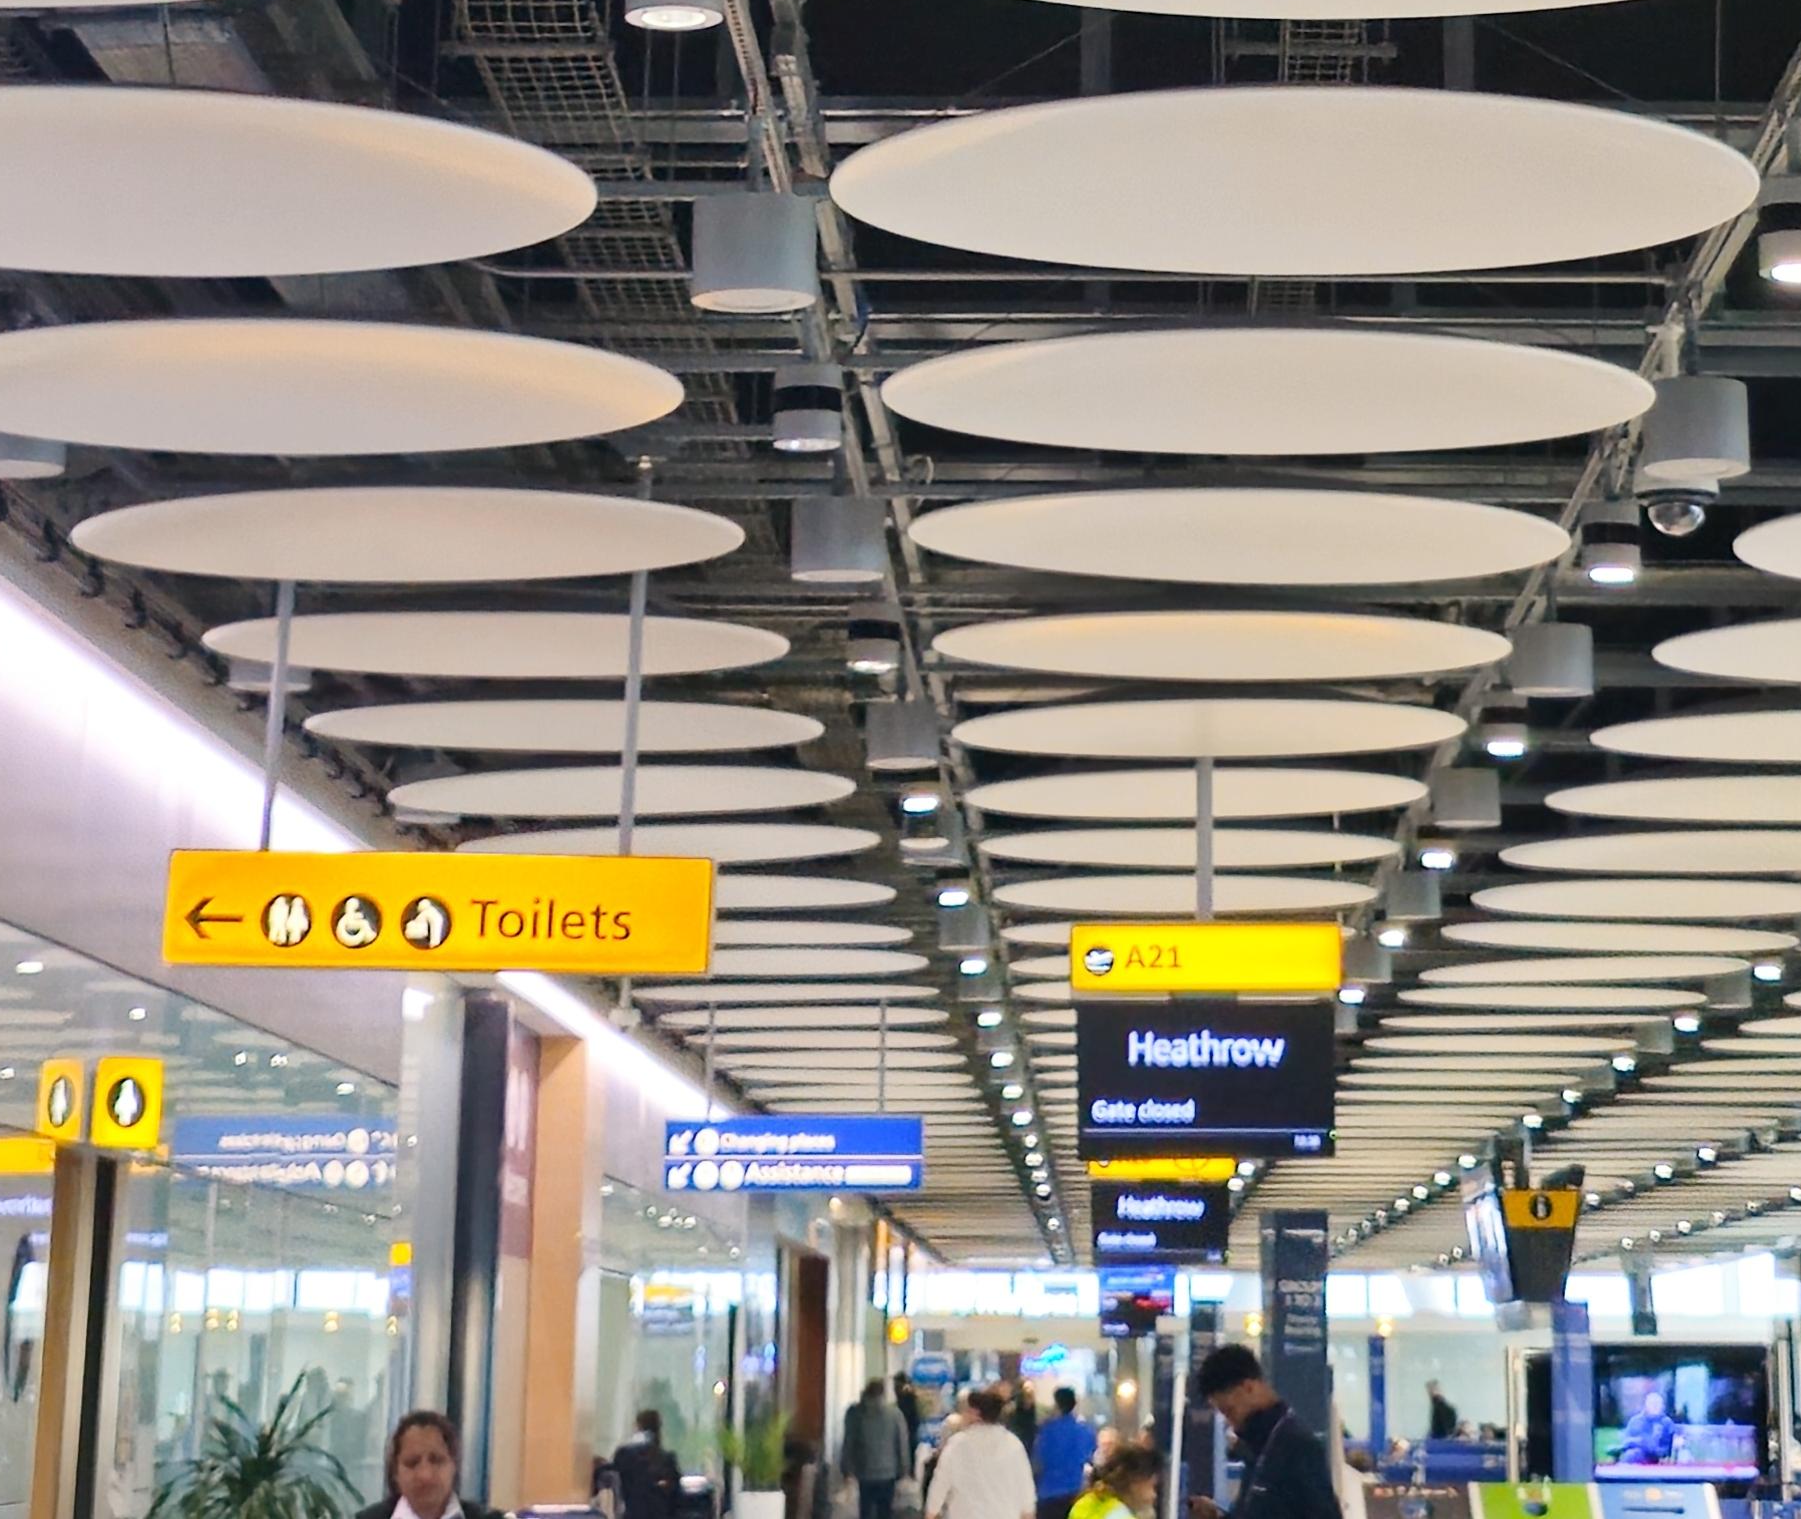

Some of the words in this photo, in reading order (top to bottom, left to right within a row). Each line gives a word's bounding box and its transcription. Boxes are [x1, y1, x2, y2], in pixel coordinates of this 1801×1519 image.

[470, 898, 632, 942] Toilets
[1125, 944, 1183, 969] A21
[1126, 1029, 1286, 1068] Heathrow
